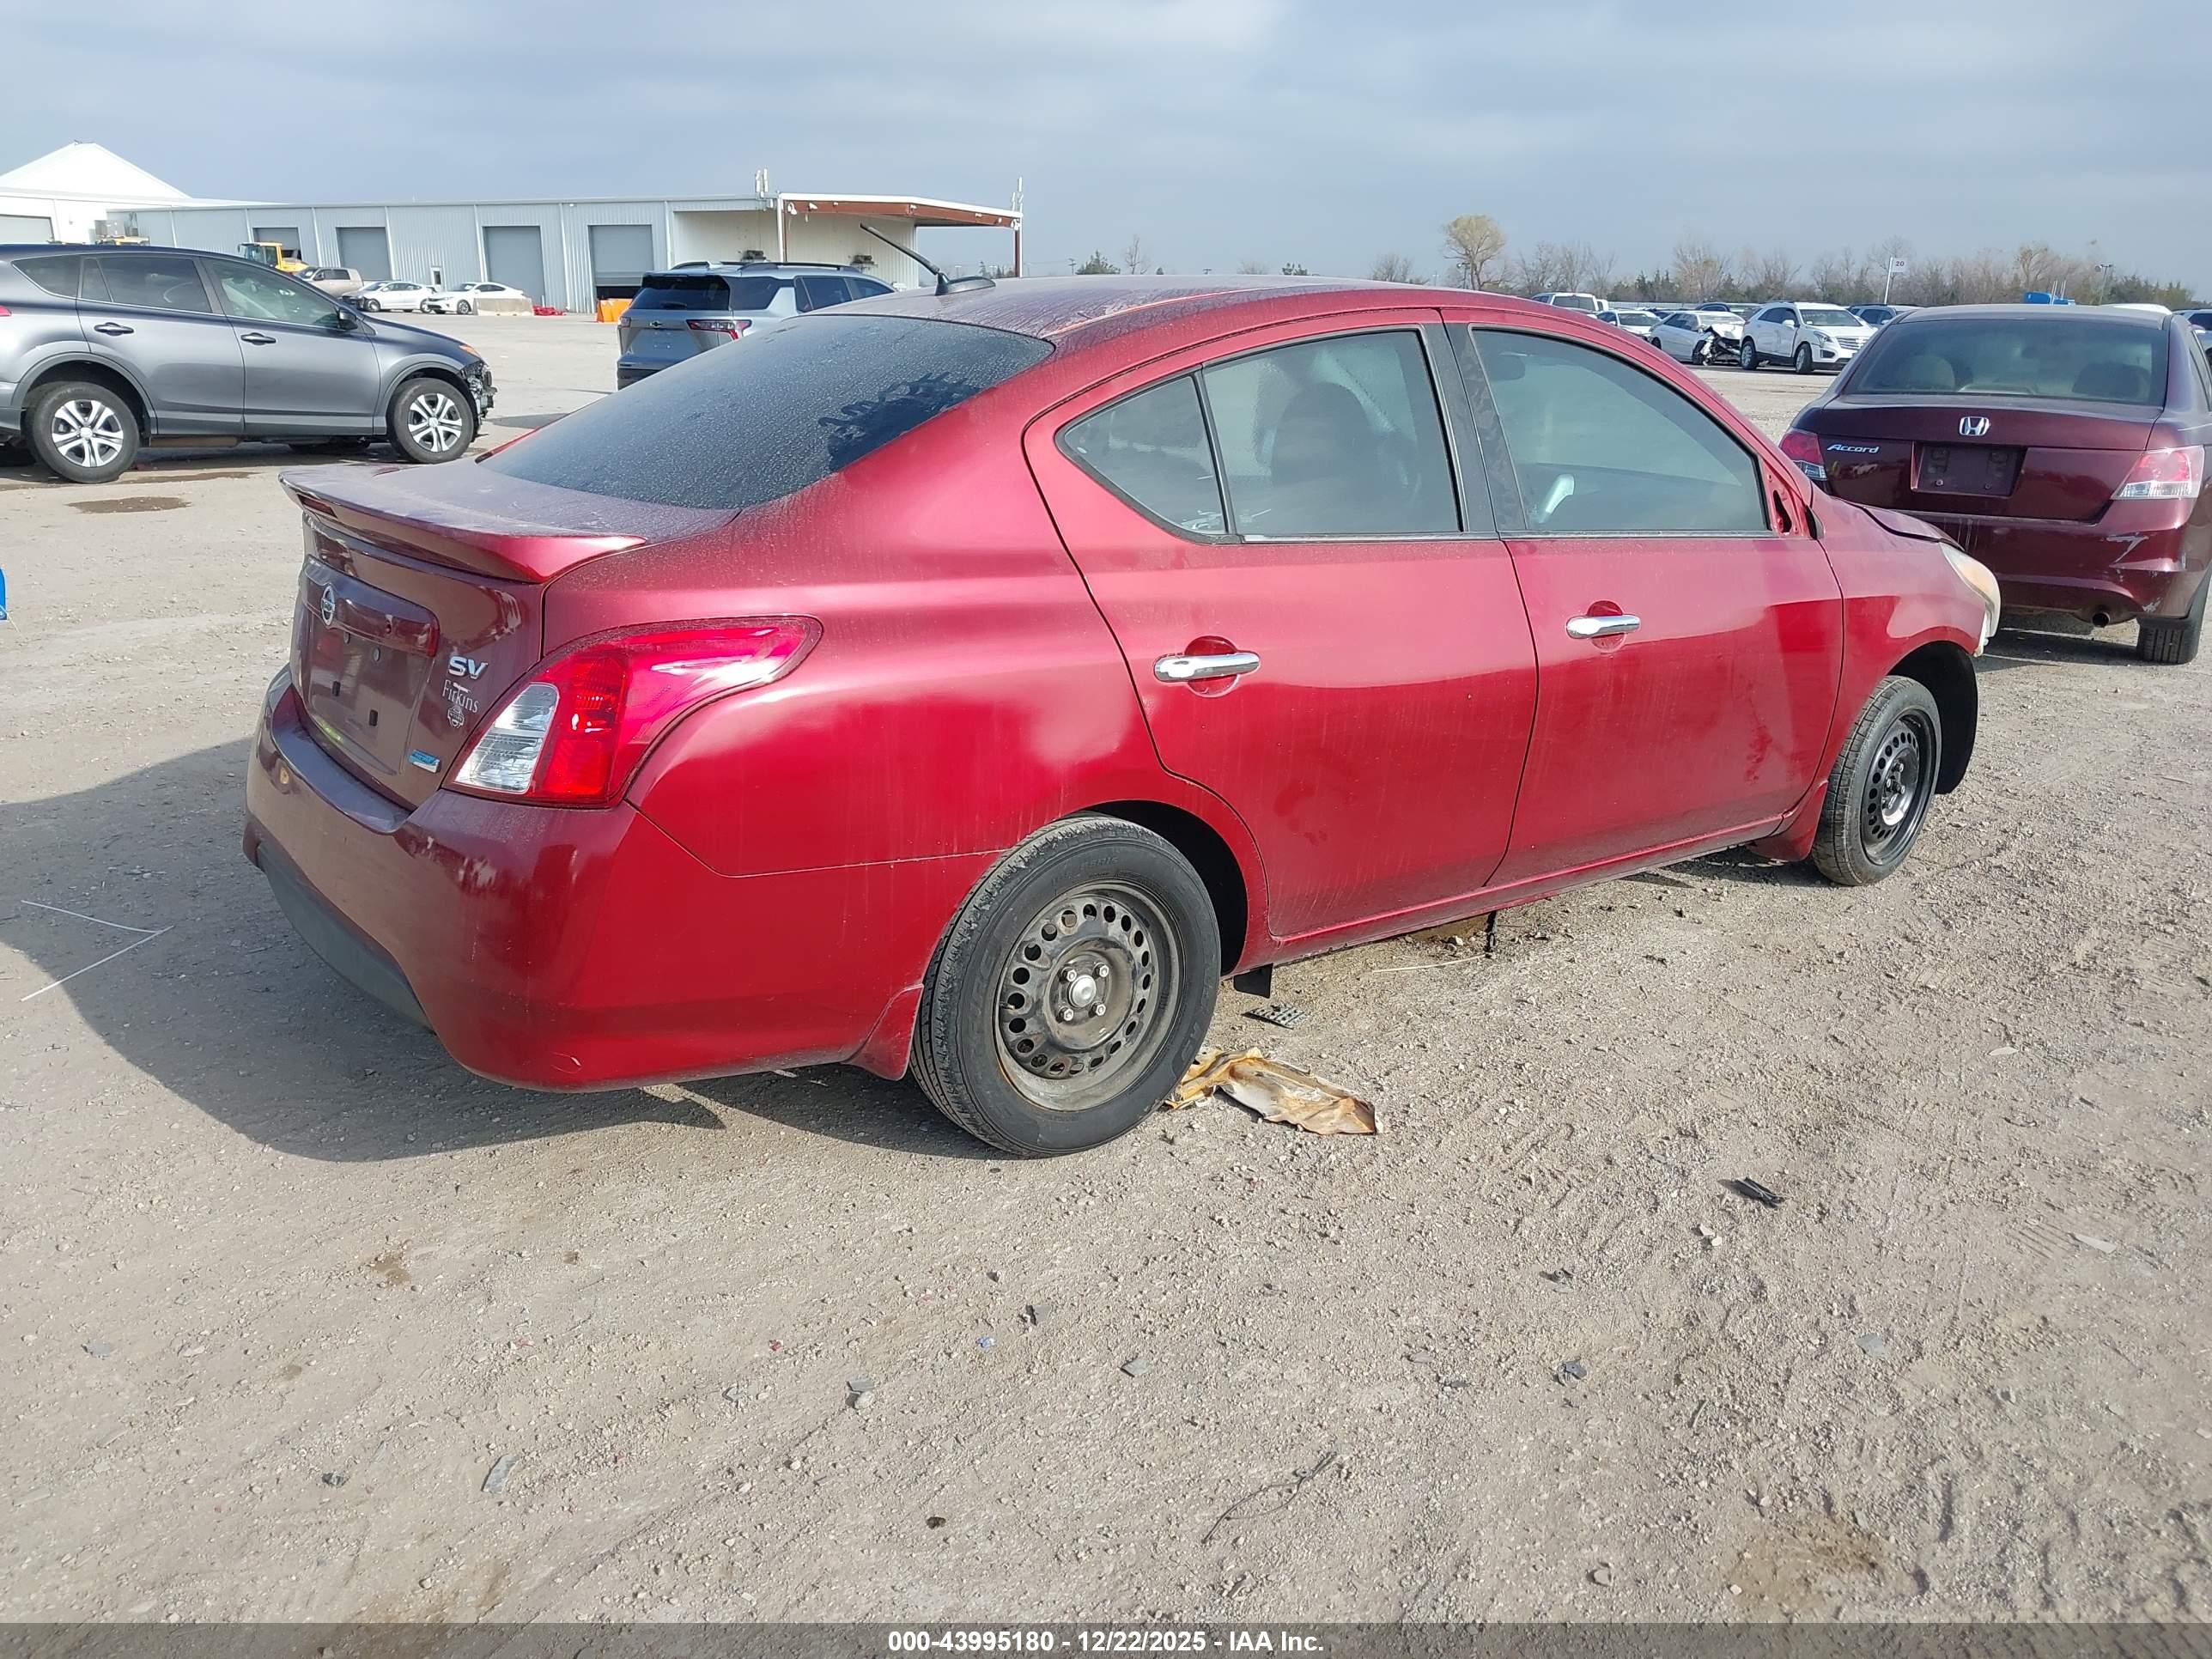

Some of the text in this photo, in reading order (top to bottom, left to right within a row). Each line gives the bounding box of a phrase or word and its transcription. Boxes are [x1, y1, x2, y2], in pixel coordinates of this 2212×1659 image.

[1826, 444, 1880, 453] Accord
[448, 655, 489, 680] SV
[442, 679, 479, 714] Firkins
